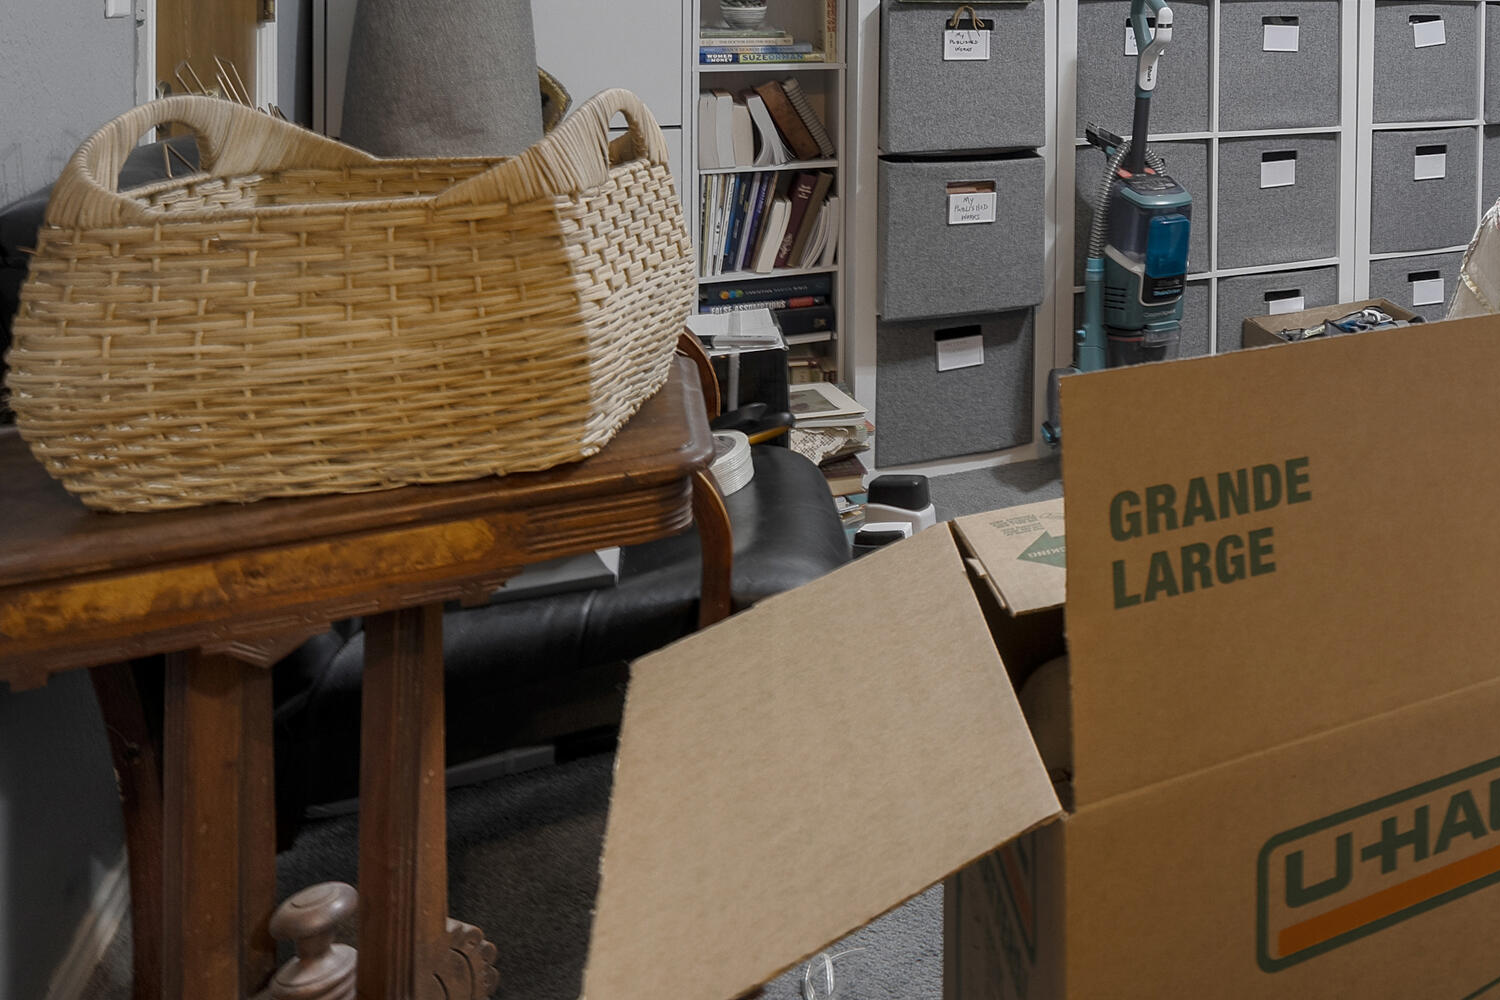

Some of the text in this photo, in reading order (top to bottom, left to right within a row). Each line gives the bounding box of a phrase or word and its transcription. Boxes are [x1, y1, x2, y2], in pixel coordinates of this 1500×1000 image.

[711, 304, 732, 314] FALSE
[1109, 456, 1312, 542] GRANDE
[1112, 526, 1277, 610] LARGE
